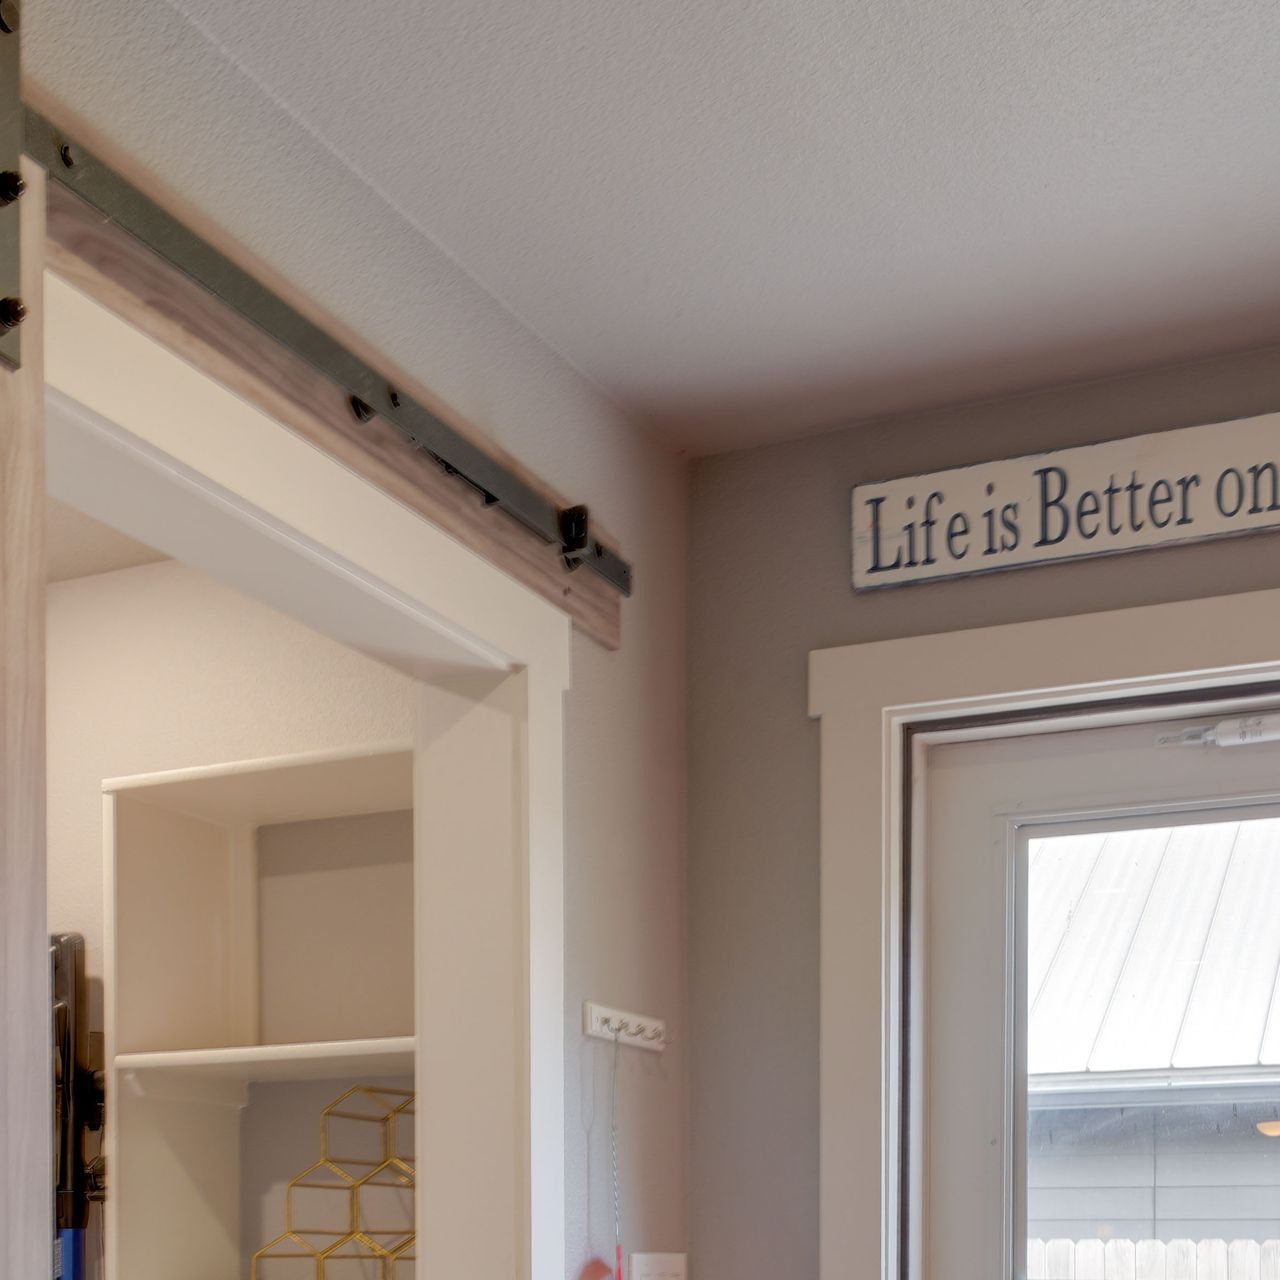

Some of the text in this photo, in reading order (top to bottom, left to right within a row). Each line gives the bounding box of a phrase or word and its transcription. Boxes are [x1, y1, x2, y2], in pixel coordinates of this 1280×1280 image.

[865, 491, 970, 574] Life
[982, 481, 1020, 556] is
[1033, 466, 1201, 549] Better
